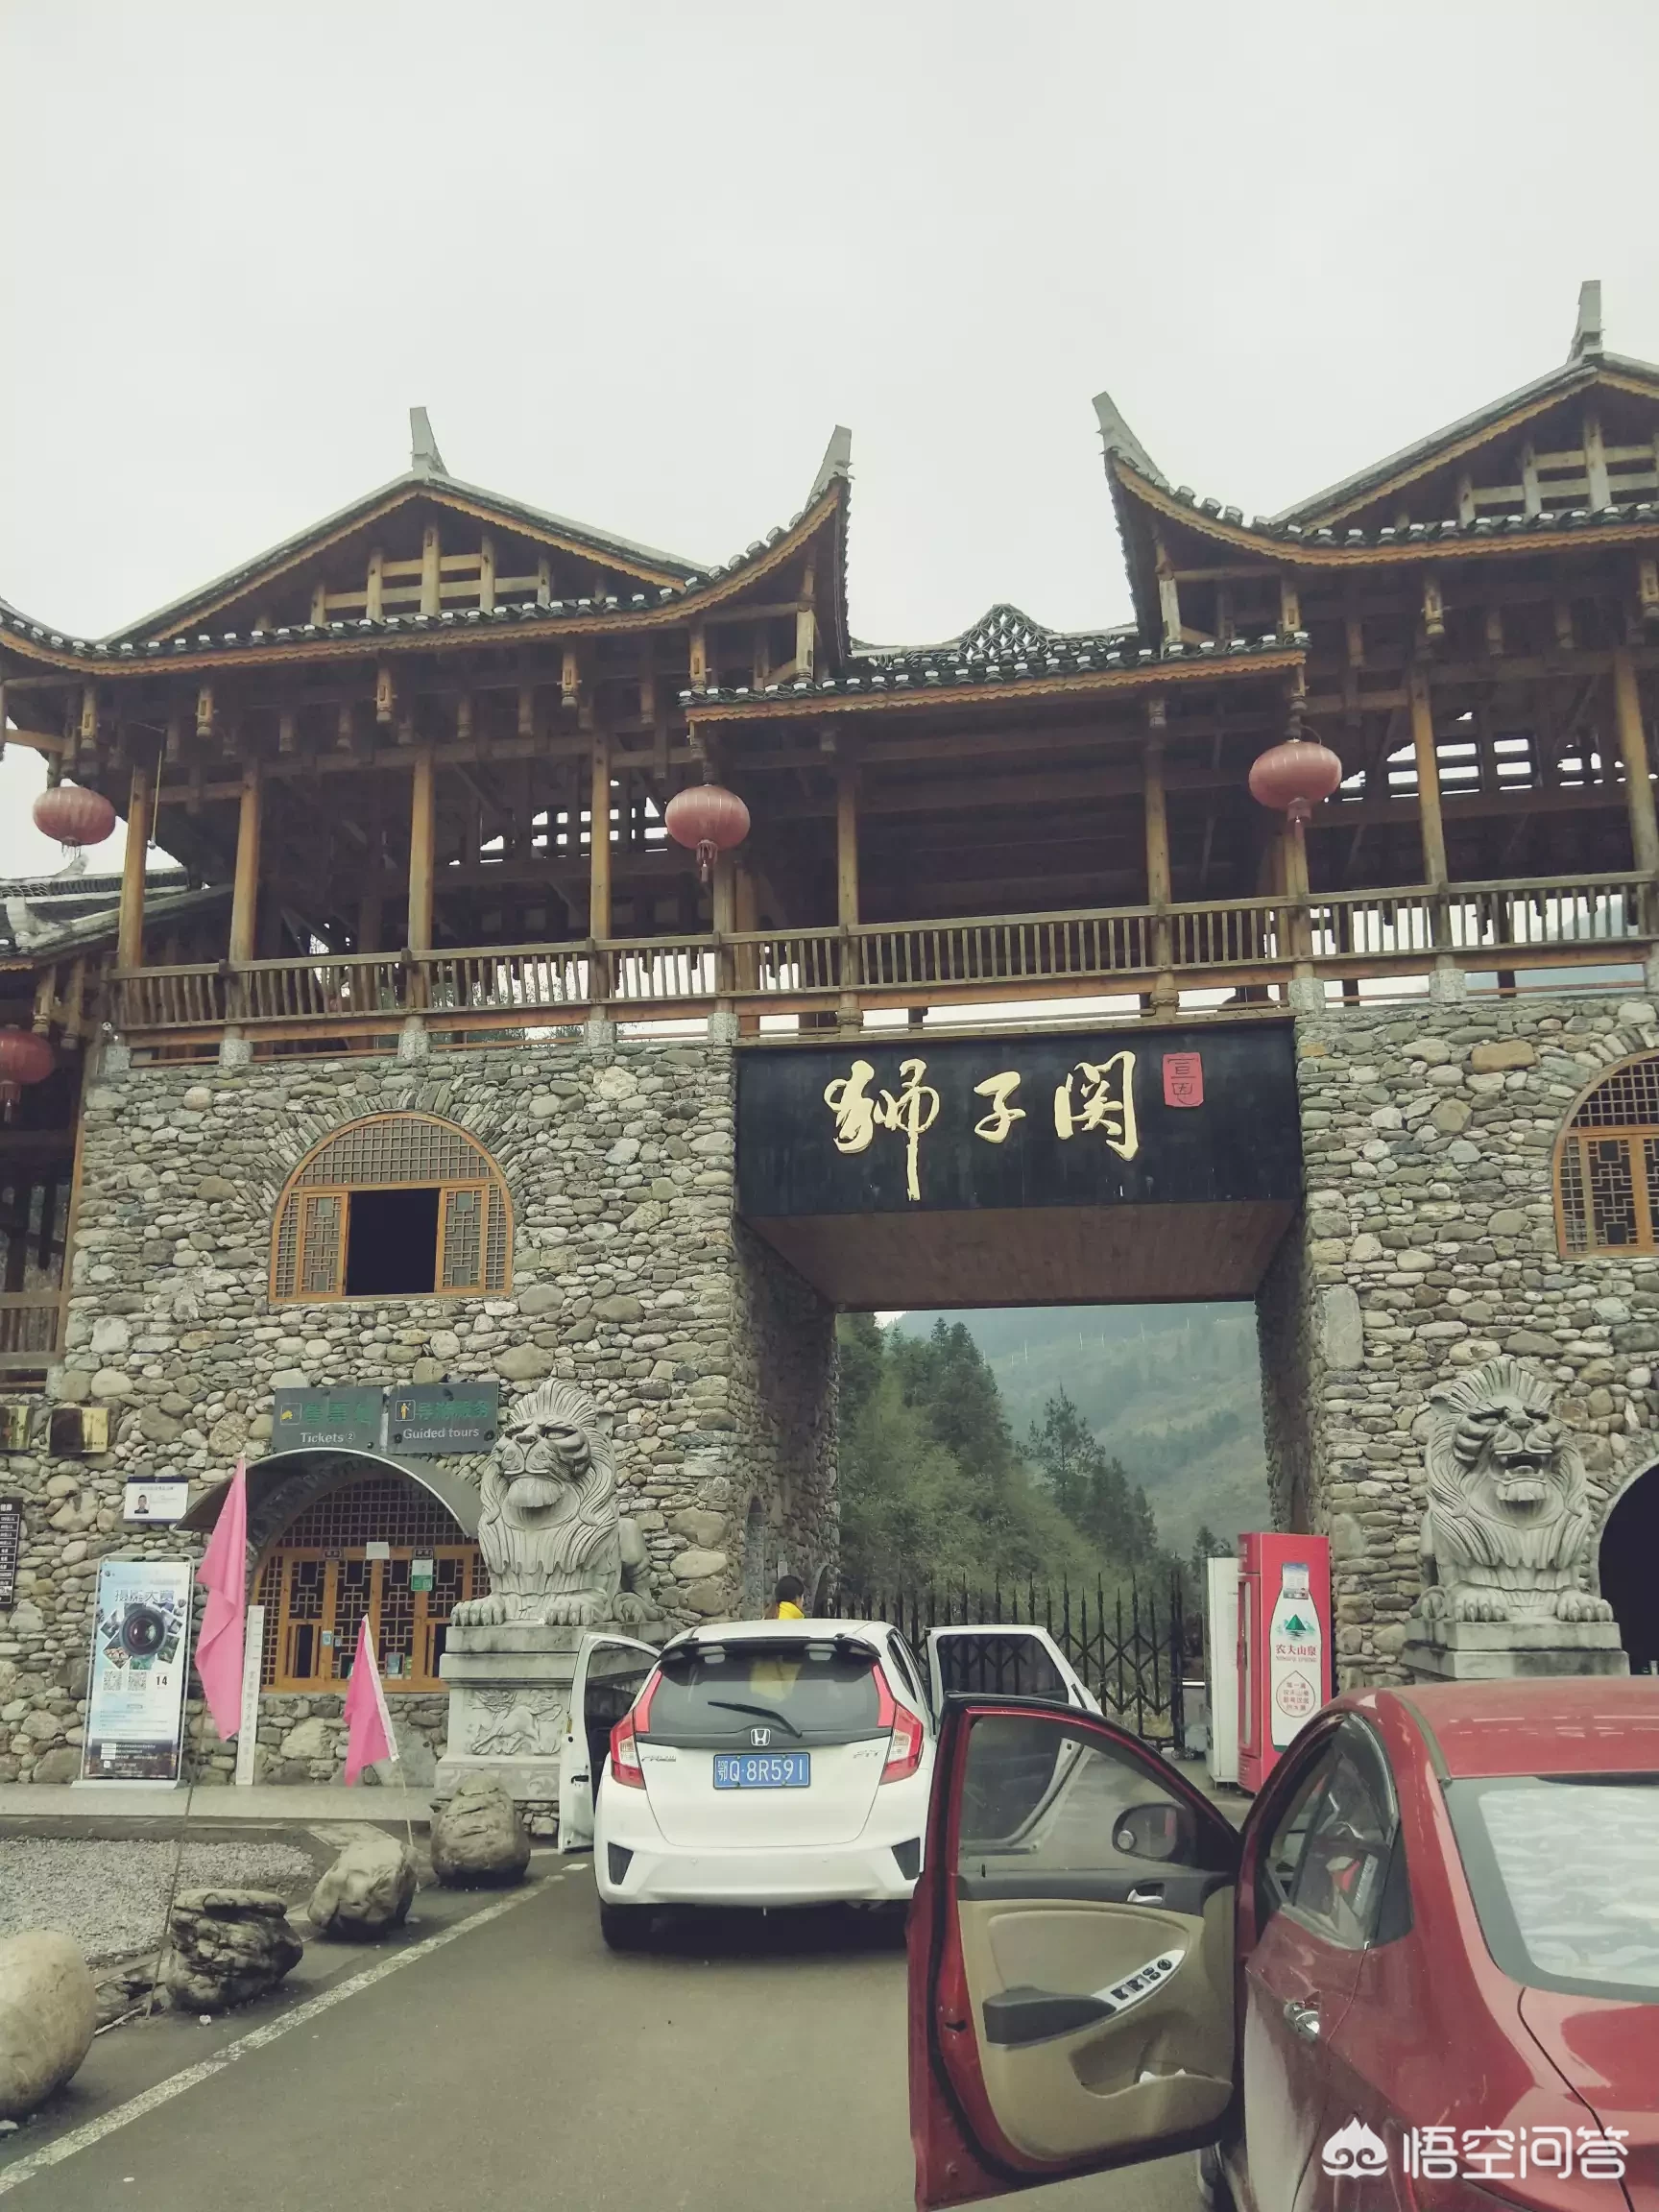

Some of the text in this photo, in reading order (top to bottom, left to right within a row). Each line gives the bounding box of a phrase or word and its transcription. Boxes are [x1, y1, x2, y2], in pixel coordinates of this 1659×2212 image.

[417, 1400, 490, 1423] 导游服务
[300, 1431, 345, 1444] Tickets
[402, 1427, 480, 1439] Guided tours
[1275, 1644, 1317, 1656] 农夫山泉
[156, 1675, 168, 1686] 14
